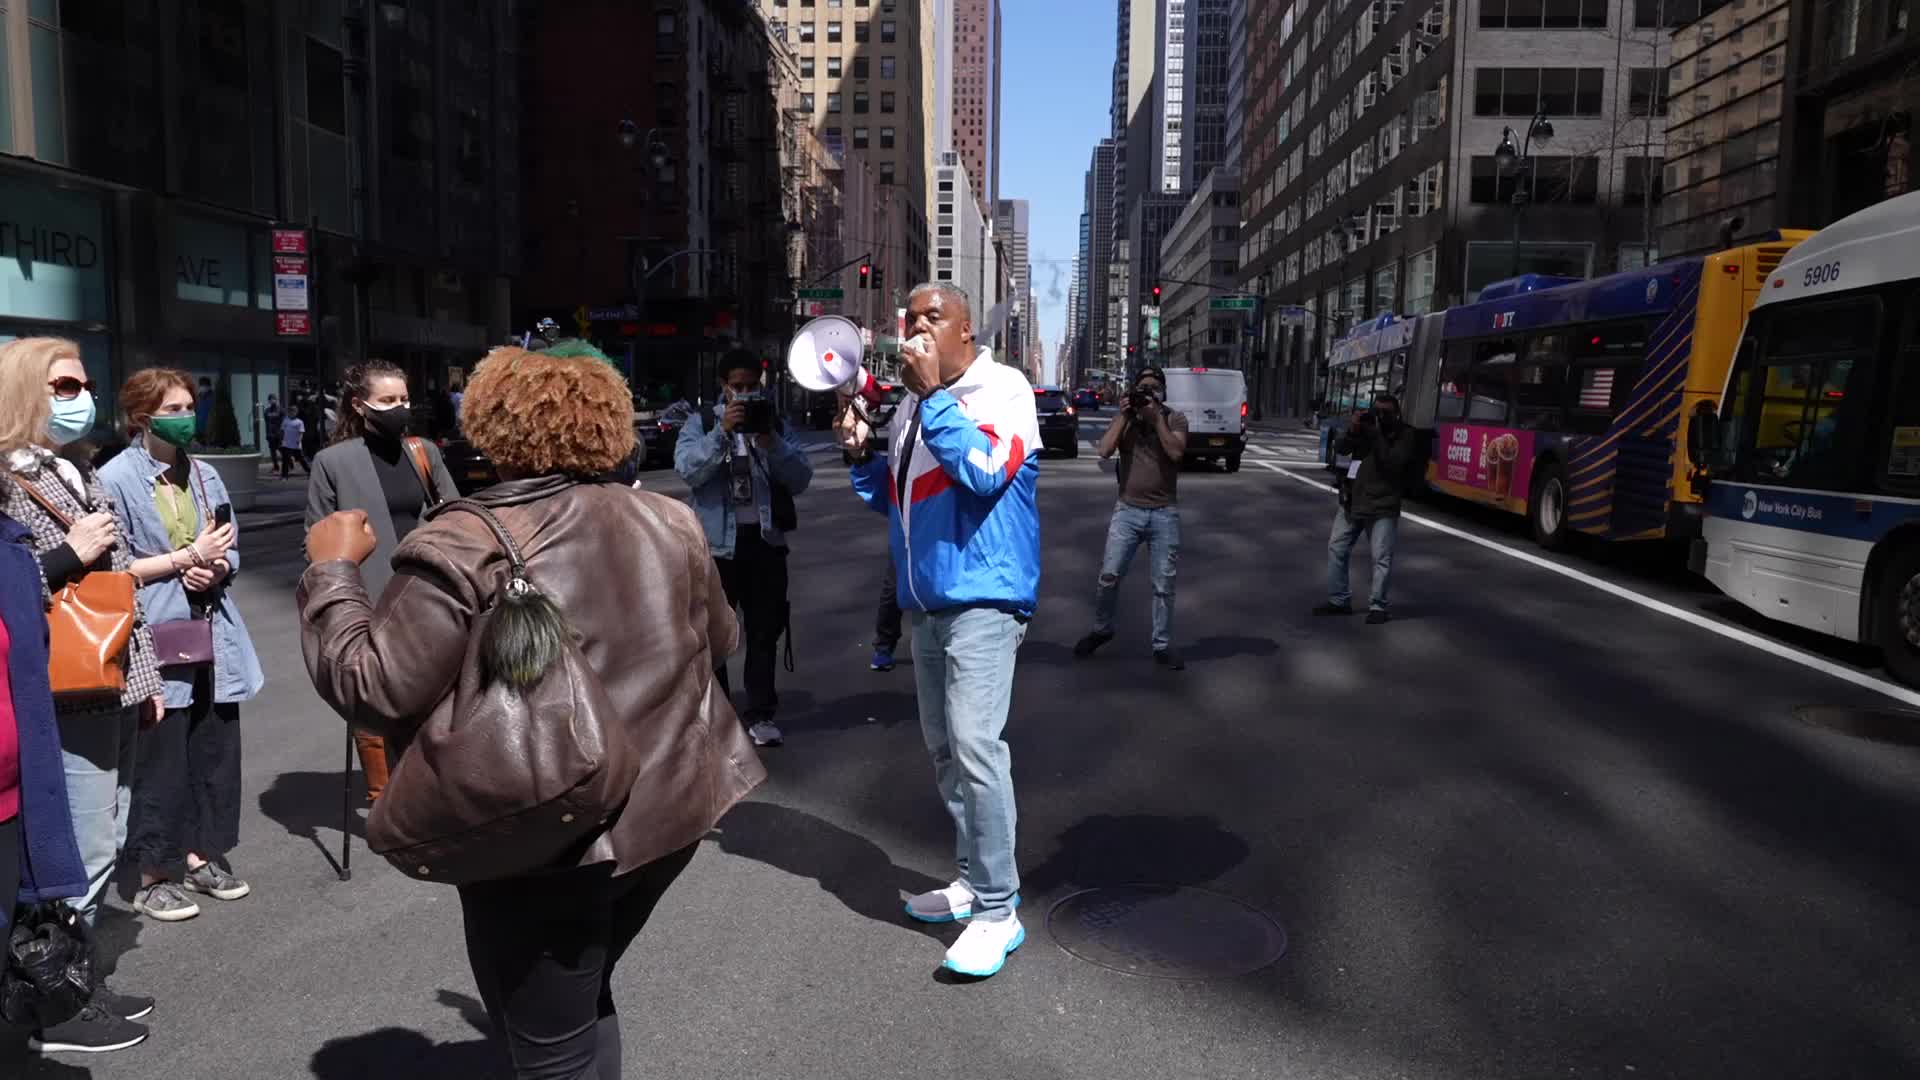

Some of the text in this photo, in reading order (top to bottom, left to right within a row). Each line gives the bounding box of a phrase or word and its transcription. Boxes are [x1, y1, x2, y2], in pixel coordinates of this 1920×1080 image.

[0, 222, 220, 288] THIRD AVE
[1803, 260, 1841, 287] 5906
[1453, 427, 1469, 444] ICED
[1447, 444, 1472, 463] COFFEE
[1759, 500, 1774, 513] New
[1775, 502, 1790, 515] York
[1791, 504, 1807, 521] City
[1808, 506, 1824, 520] Bus
